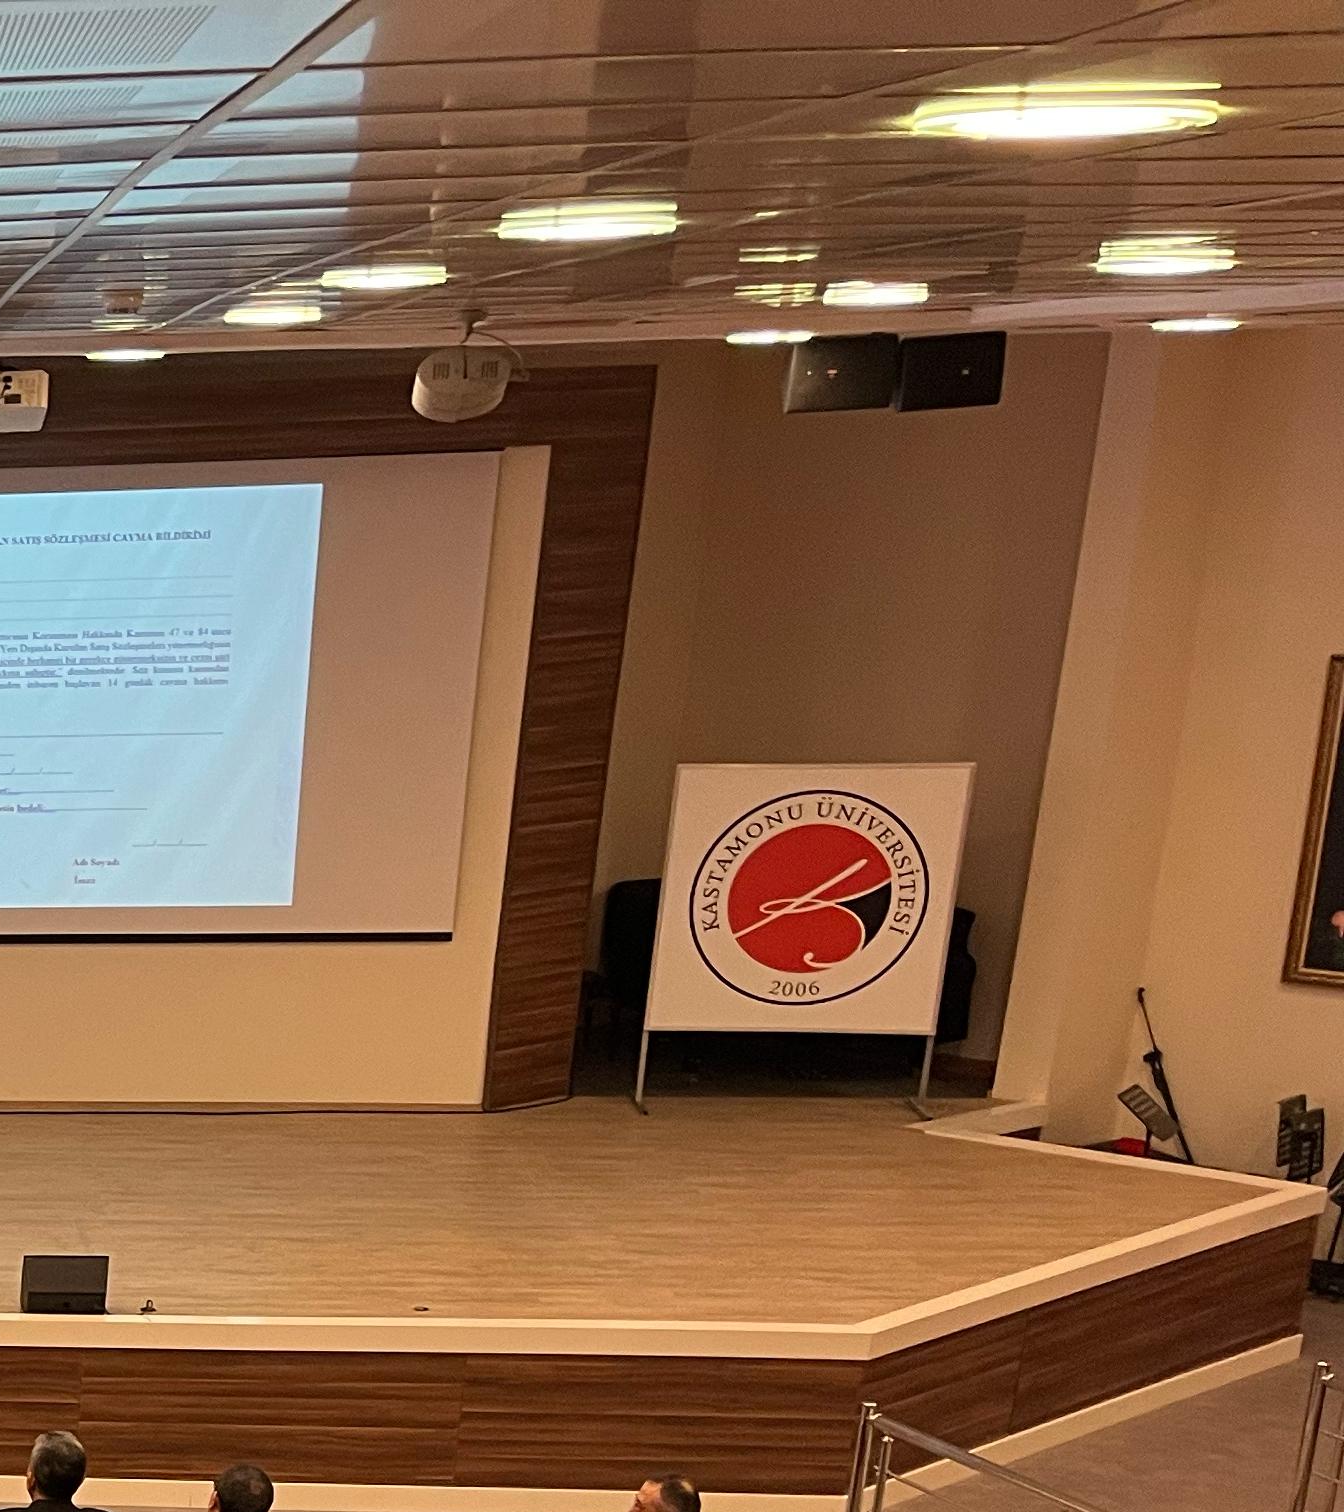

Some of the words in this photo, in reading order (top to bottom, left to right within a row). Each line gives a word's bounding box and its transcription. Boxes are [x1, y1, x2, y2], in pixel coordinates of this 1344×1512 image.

[702, 803, 804, 933] KASTAMONU
[815, 796, 921, 937] ÜNİVERSİTESİ
[768, 979, 820, 998] 2006
